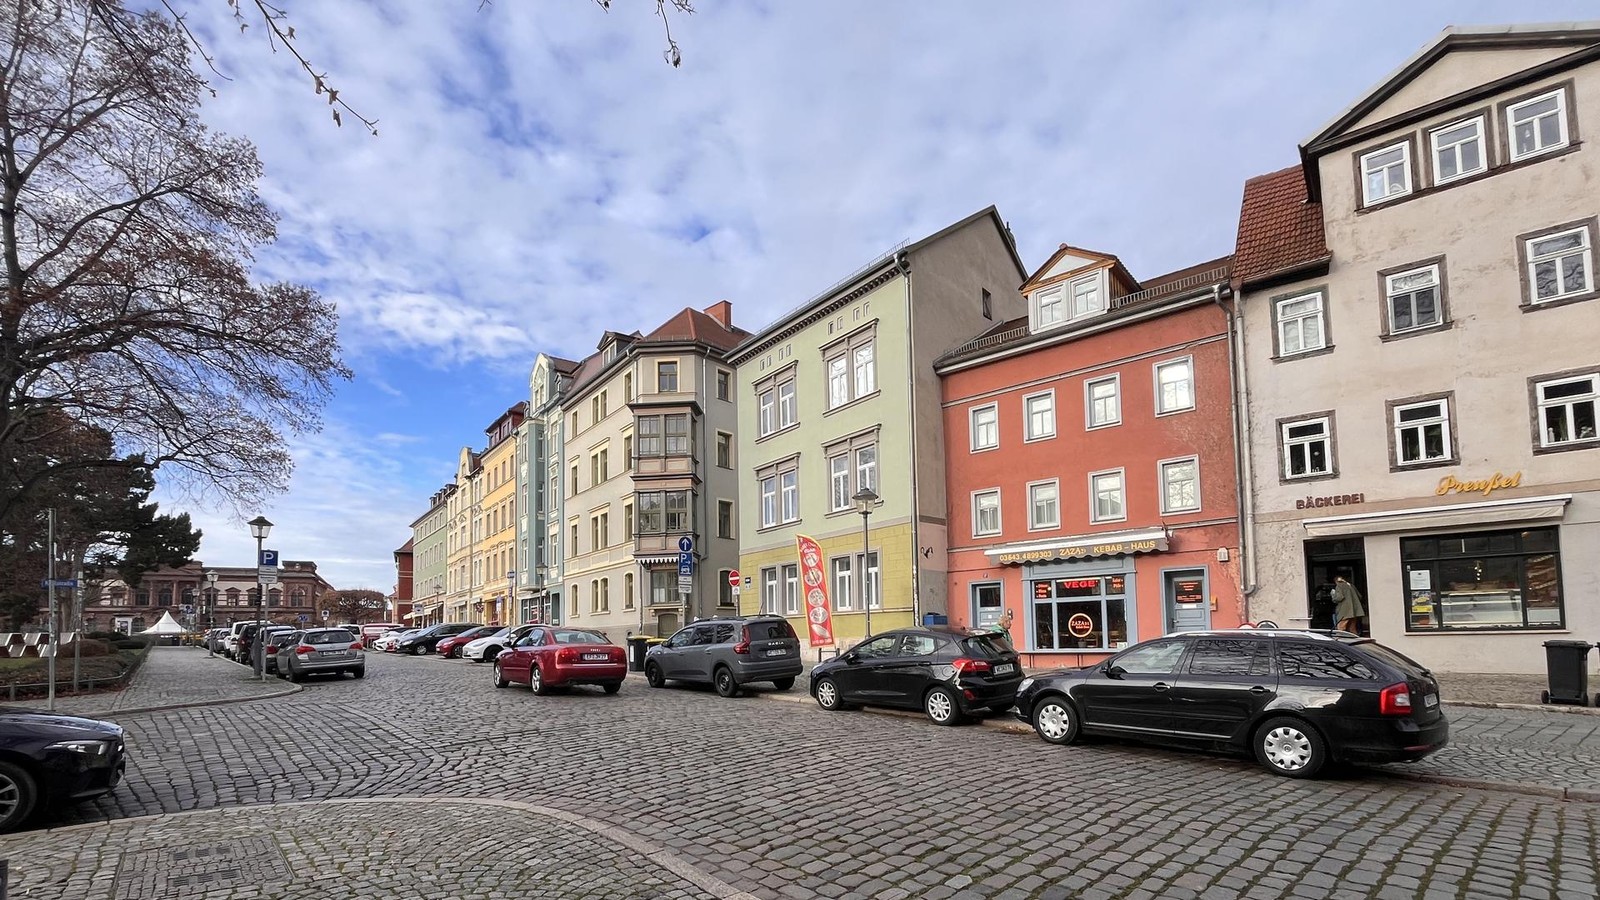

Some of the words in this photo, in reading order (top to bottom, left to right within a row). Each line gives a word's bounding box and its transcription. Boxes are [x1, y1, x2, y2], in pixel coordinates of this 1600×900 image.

[1436, 470, 1521, 496] Preußel
[1296, 493, 1365, 510] BÄCKEREI
[1093, 544, 1123, 553] KEBAB
[1130, 541, 1156, 550] HAUS
[263, 552, 274, 564] P
[680, 553, 687, 563] P
